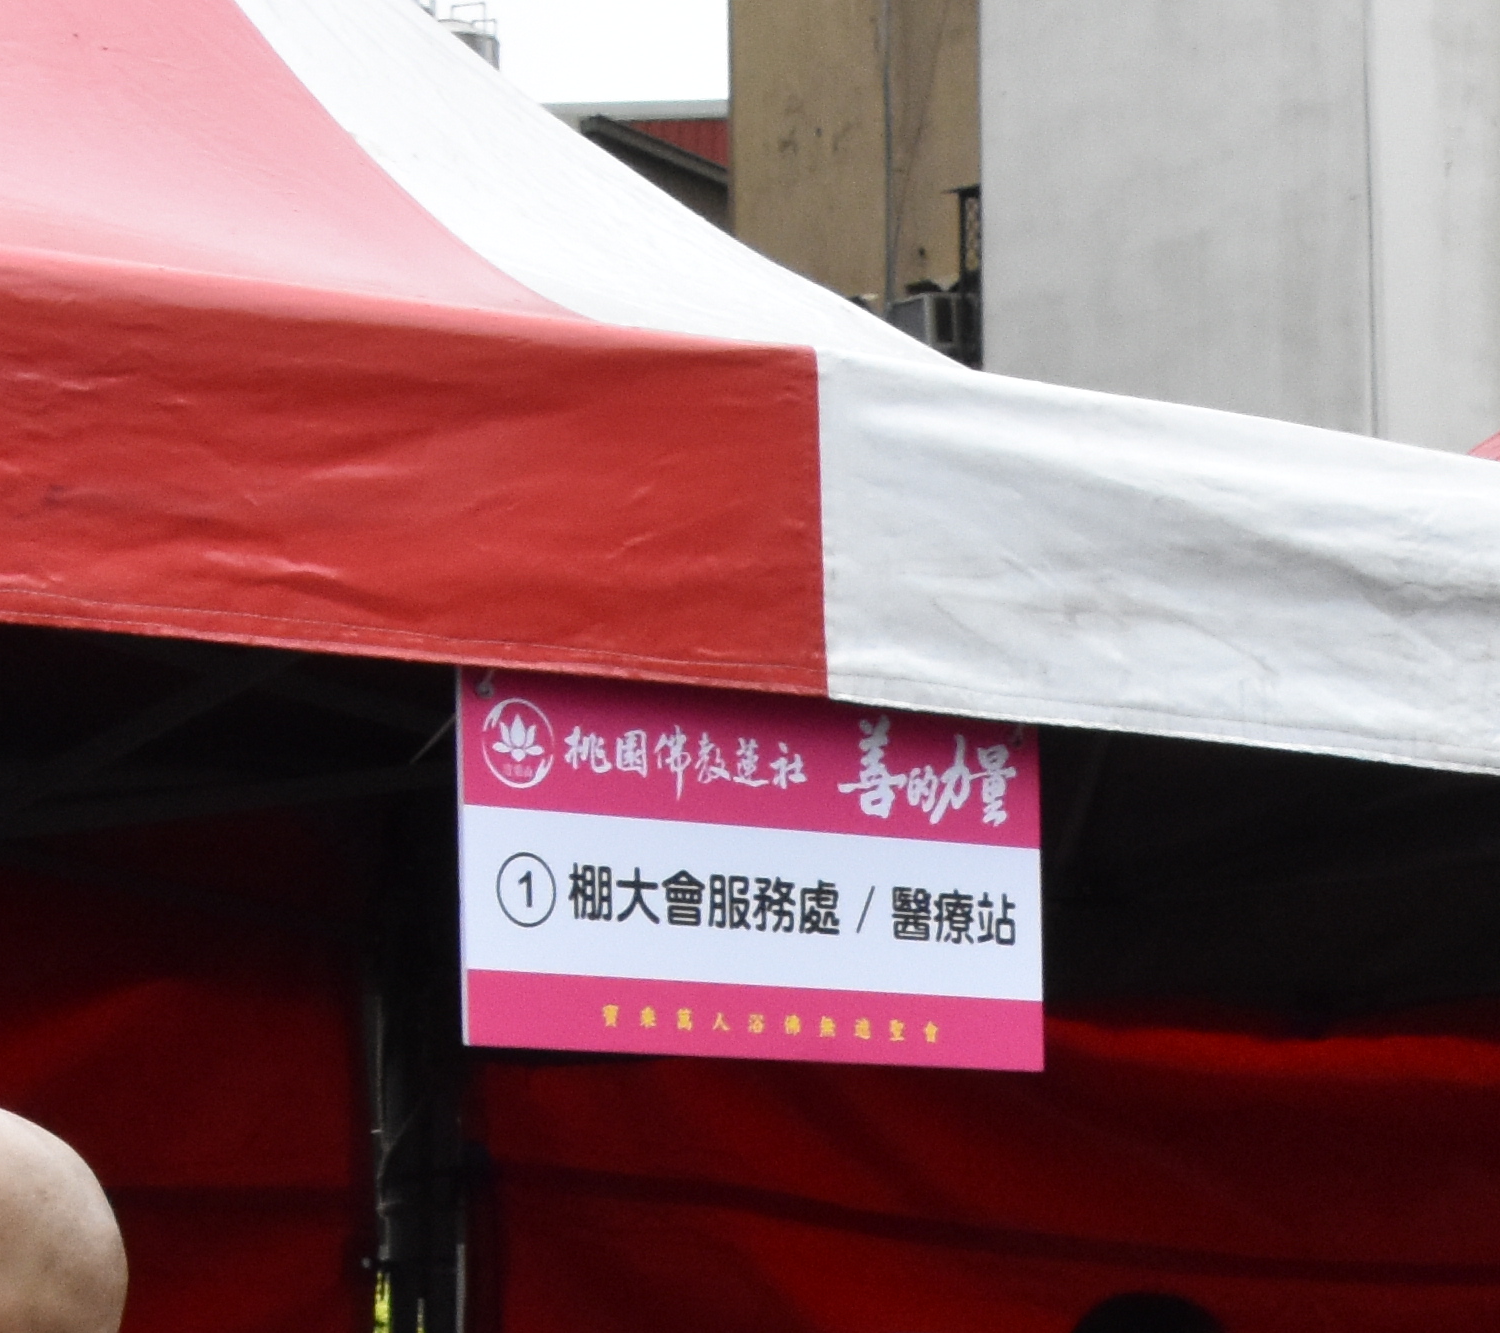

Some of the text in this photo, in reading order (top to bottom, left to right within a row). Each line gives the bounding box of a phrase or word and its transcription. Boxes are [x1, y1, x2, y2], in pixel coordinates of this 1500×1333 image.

[564, 716, 1017, 827] 桃園佛教蓮社 善的力量
[891, 886, 1017, 946] 醫療站
